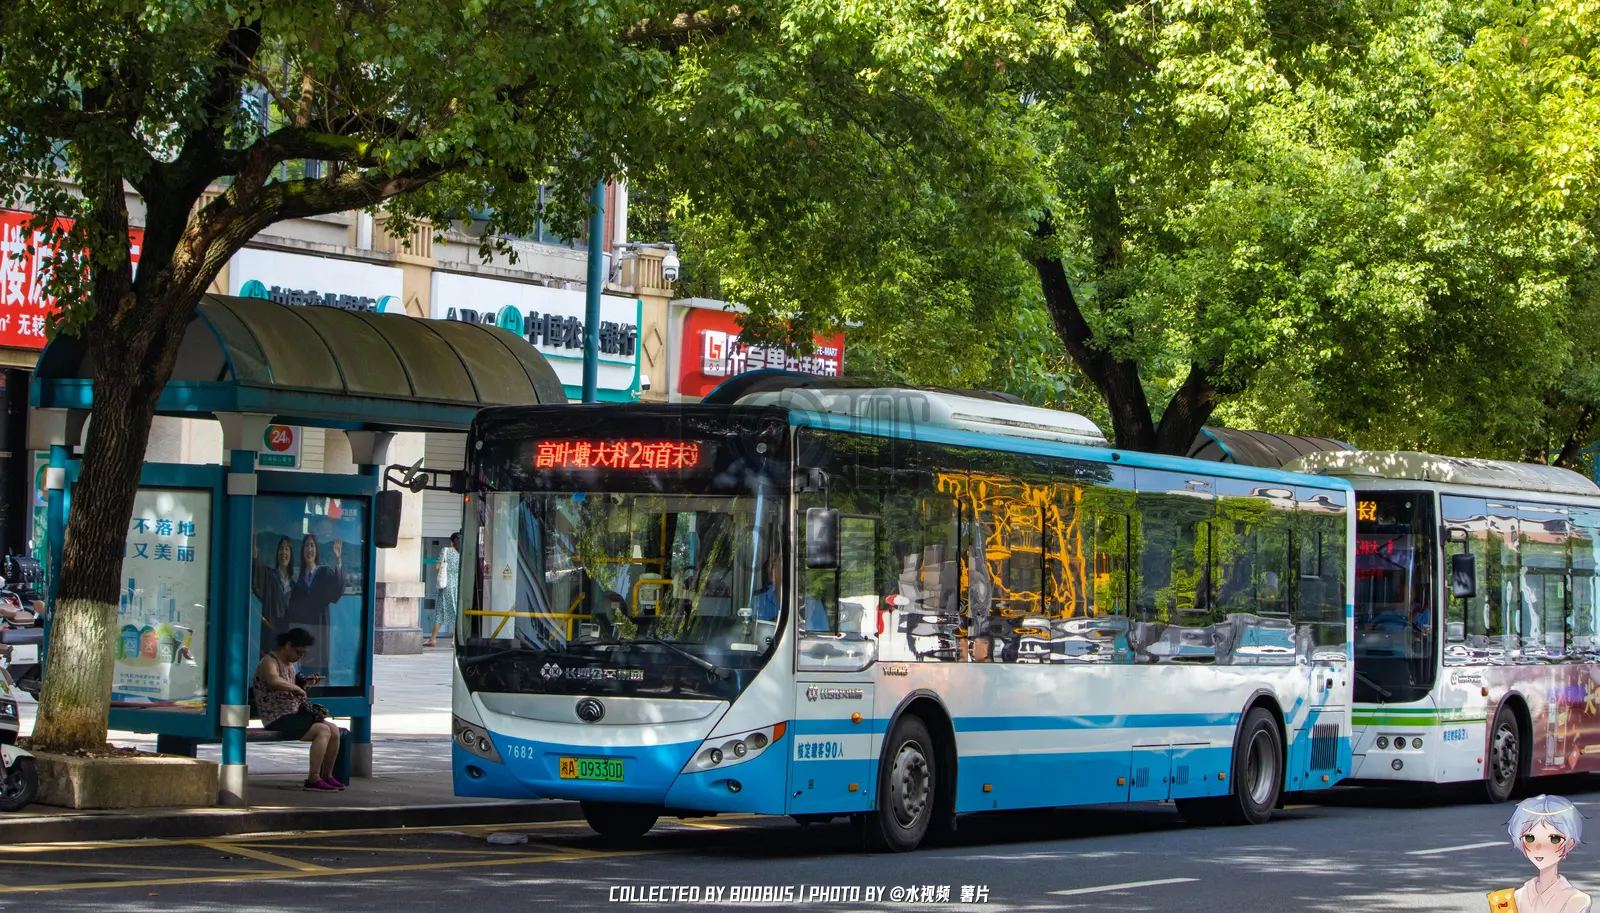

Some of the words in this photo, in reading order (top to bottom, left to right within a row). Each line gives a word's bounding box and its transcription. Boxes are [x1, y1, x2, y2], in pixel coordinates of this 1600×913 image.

[524, 310, 637, 356] 中国农银行
[132, 517, 197, 538] 不落地
[123, 541, 196, 562] 又美丽
[507, 744, 534, 760] 7682
